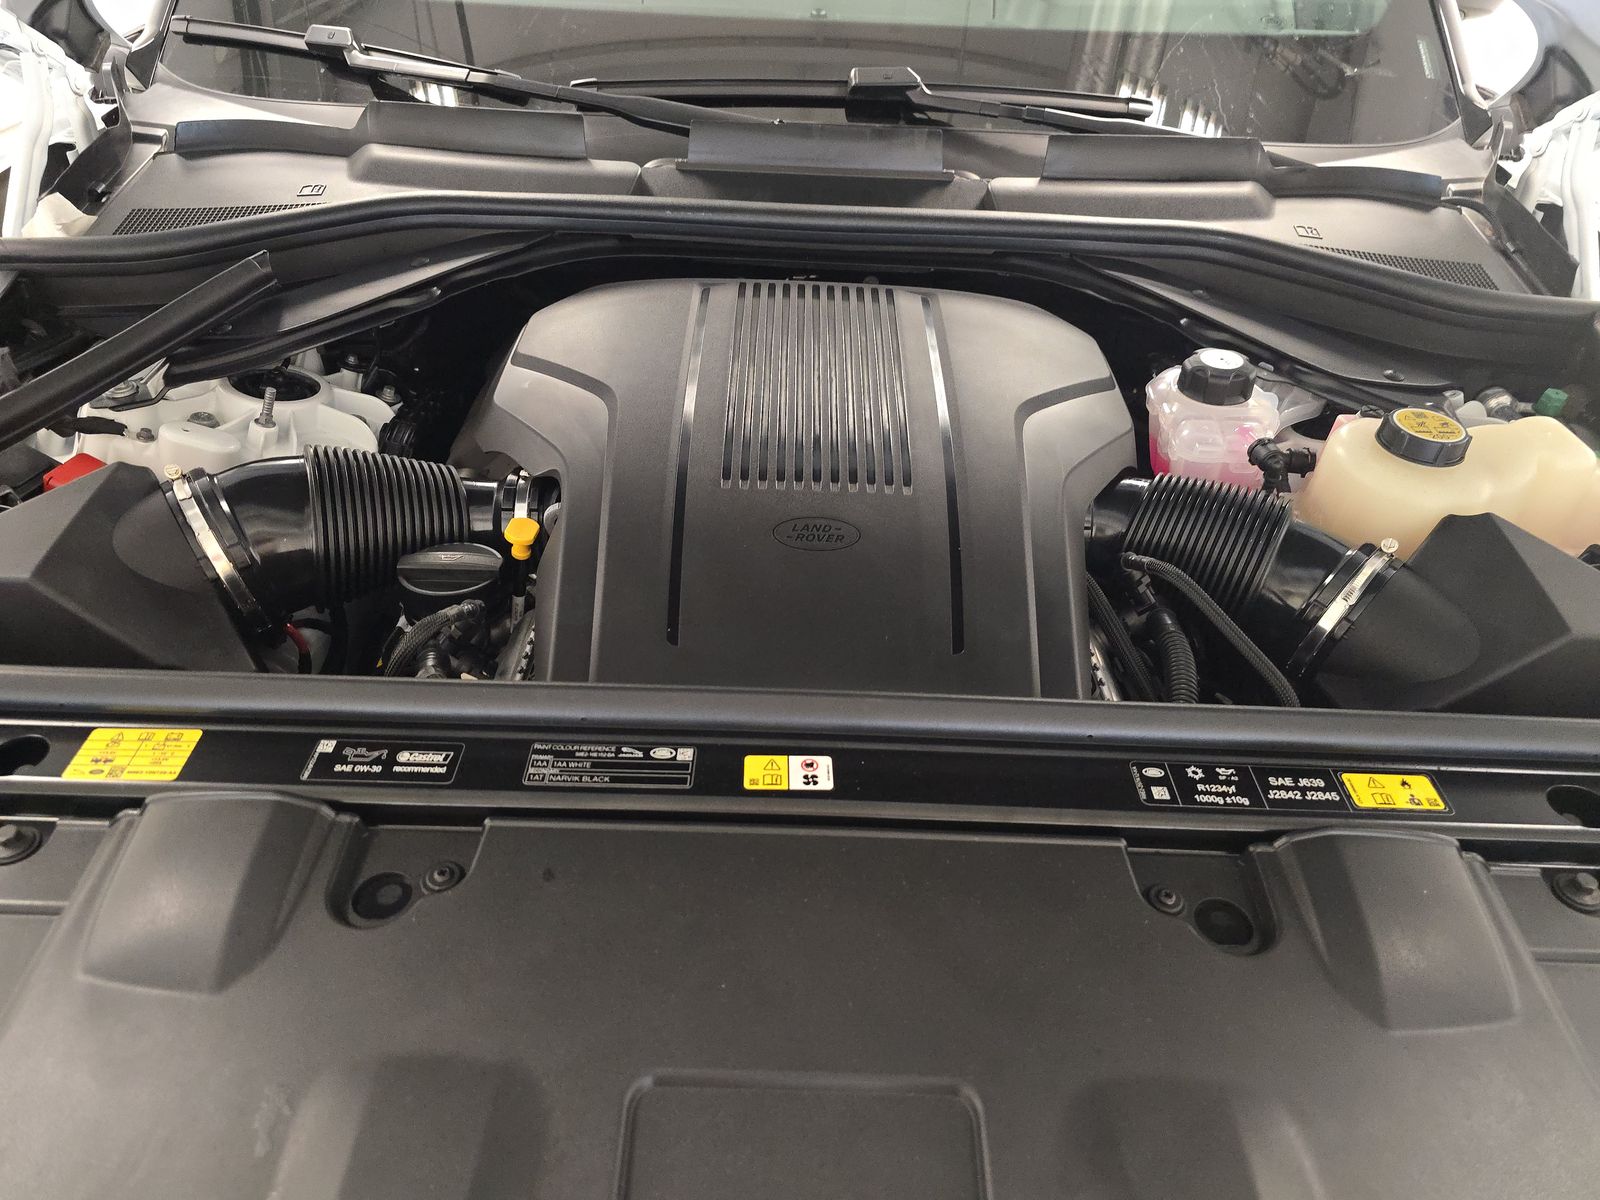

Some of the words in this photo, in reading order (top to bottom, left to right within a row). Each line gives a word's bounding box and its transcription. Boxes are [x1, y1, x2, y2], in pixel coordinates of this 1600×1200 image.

[410, 752, 445, 762] Castrol
[333, 763, 353, 773] SAE
[354, 764, 383, 773] 0W-30
[533, 760, 547, 768] 1AA
[568, 761, 592, 769] WHITE
[392, 765, 447, 774] recommended
[529, 773, 544, 781] 1AT
[549, 774, 580, 782] NARVIK
[581, 775, 610, 783] BLACK
[1267, 776, 1295, 786] SAE
[1297, 777, 1325, 788] J639
[1193, 794, 1225, 805] 1000g
[1225, 796, 1250, 806] ±10g
[1267, 789, 1303, 800] J2842
[1304, 790, 1340, 802] J2845
